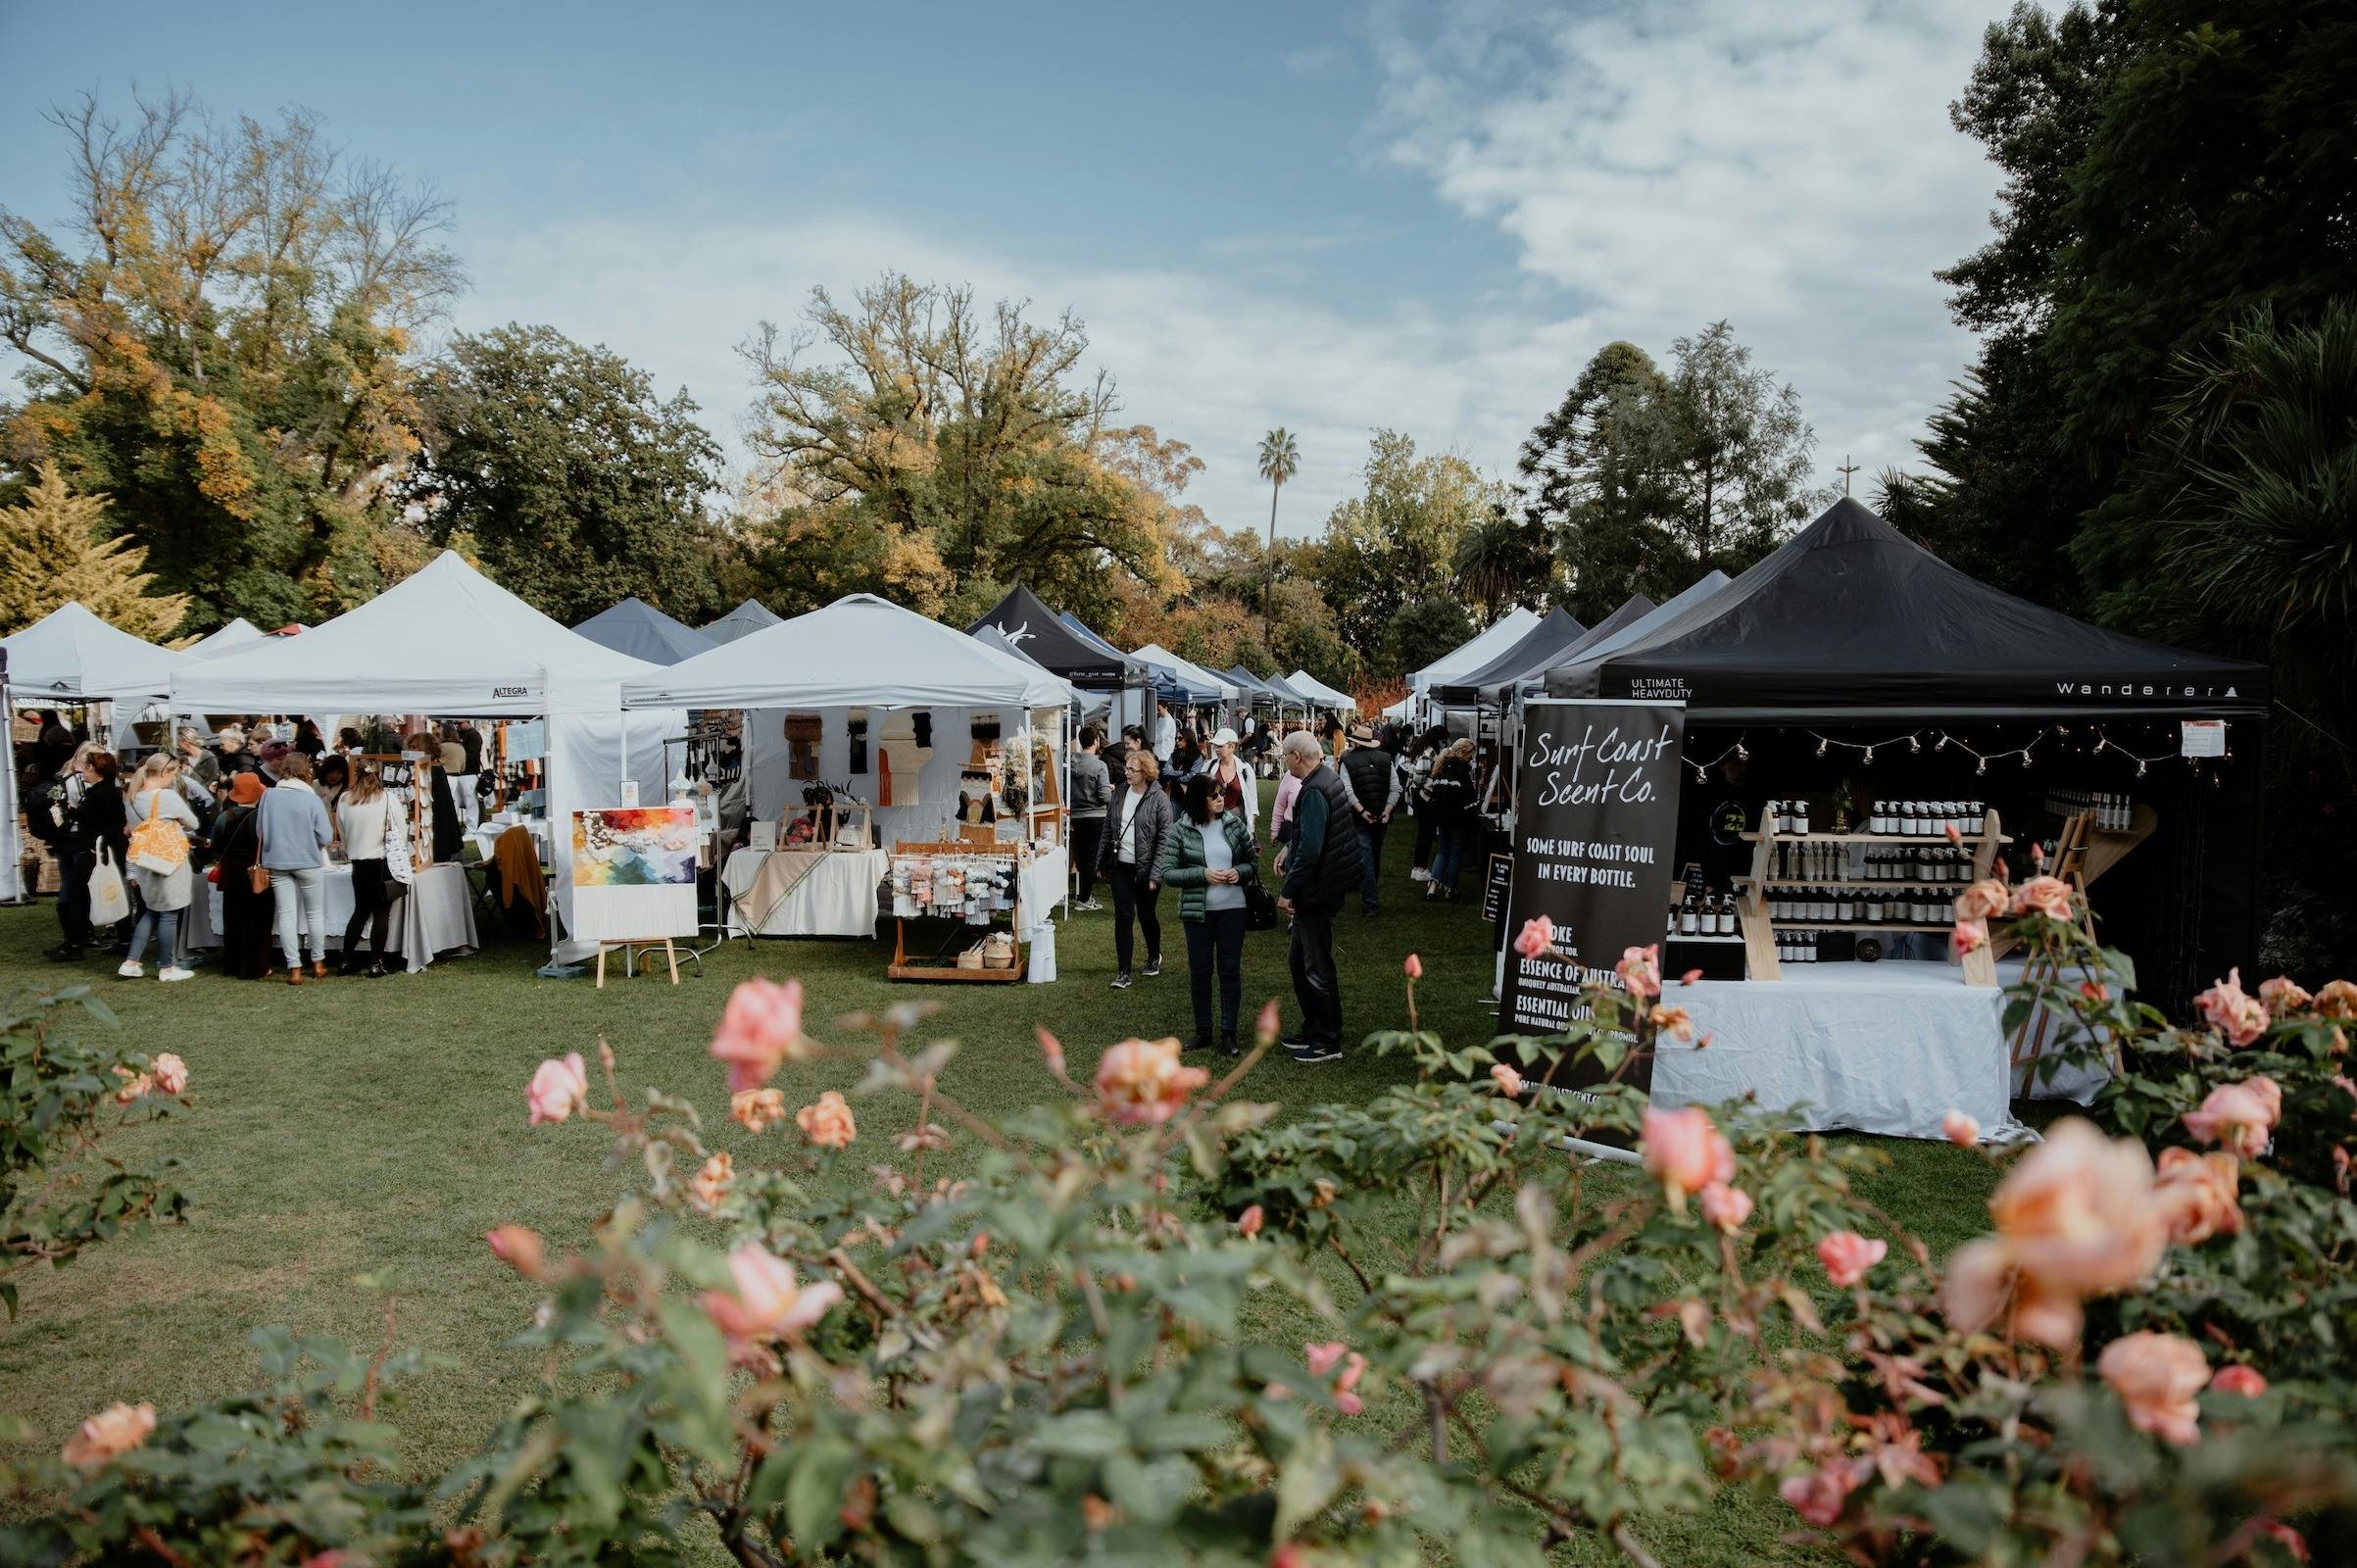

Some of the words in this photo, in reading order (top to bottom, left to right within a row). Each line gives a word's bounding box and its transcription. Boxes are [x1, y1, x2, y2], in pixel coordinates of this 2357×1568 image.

[492, 687, 528, 699] ALTEGRA
[1632, 678, 1684, 688] ULTIMATE
[2057, 683, 2214, 697] Wanderer
[1632, 689, 1693, 699] HEAVYDUTY
[1529, 724, 1595, 782] Surf
[1596, 723, 1674, 763] Coast
[1538, 768, 1619, 807] Scent
[1619, 766, 1656, 804] Co.
[1527, 837, 1554, 856] SOME
[1557, 840, 1585, 858] SURF
[1588, 842, 1622, 861] COAST
[1624, 845, 1654, 864] SOUL
[1538, 863, 1550, 879] IN
[1553, 865, 1589, 883] EVERY
[1591, 869, 1636, 889] BOTTLE.
[1519, 958, 1563, 980] ESSENCE
[1564, 964, 1580, 982] OF
[1518, 977, 1547, 991] UNIQUELY
[1516, 995, 1569, 1019] ESSENTIAL
[1514, 1013, 1530, 1025] PURE
[1530, 1016, 1555, 1029] NATURAL
